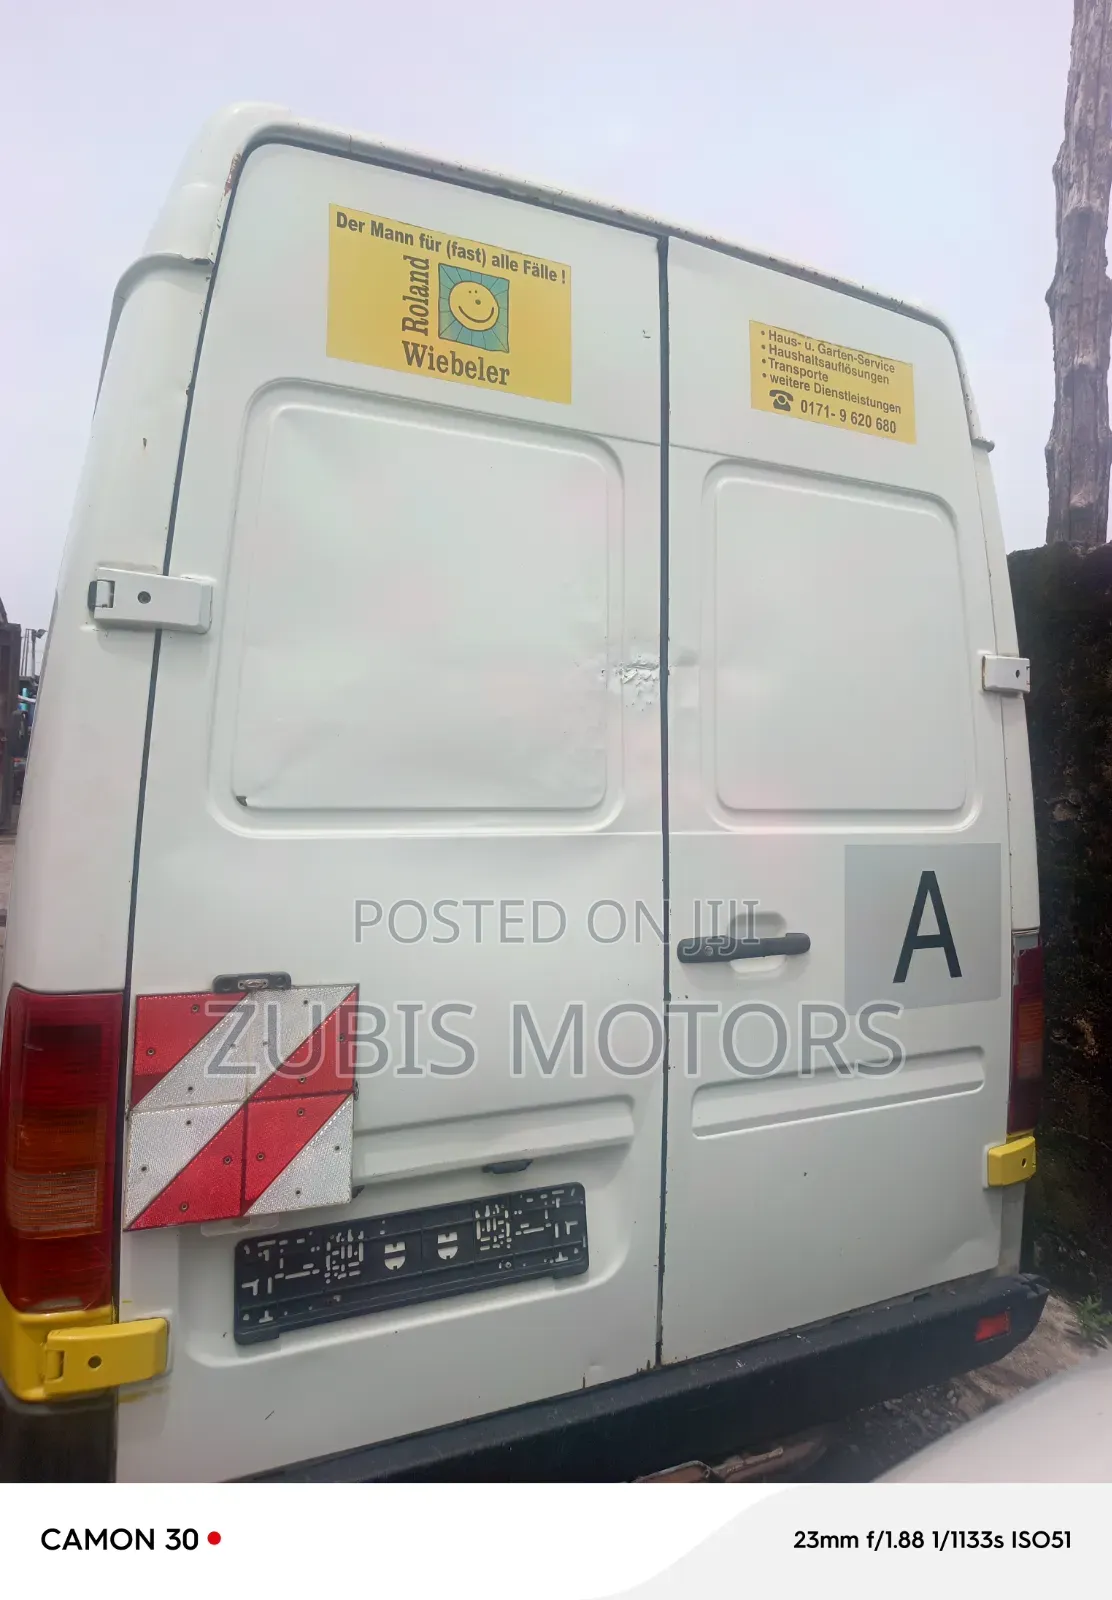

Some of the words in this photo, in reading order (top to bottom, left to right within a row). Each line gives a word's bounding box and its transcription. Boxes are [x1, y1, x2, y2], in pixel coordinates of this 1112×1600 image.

[336, 211, 365, 233] Der
[370, 220, 414, 246] Mann
[419, 232, 442, 252] für
[446, 239, 487, 268] (fast)
[491, 255, 519, 272] alle
[523, 260, 558, 282] Fälle
[401, 254, 430, 336] Roland
[401, 340, 510, 385] Wiebeler
[768, 330, 802, 347] Haus-
[805, 340, 815, 351] u.
[817, 343, 895, 373] Garten-Service
[768, 357, 829, 382] Transporte
[769, 344, 889, 385] Haushaltsauflösungen
[770, 373, 811, 391] weitere
[814, 383, 902, 414] Dienstleistungen
[801, 400, 836, 419] 0171-
[839, 408, 847, 422] 9
[851, 411, 872, 428] 620
[876, 420, 897, 434] 680
[892, 870, 964, 984] A
